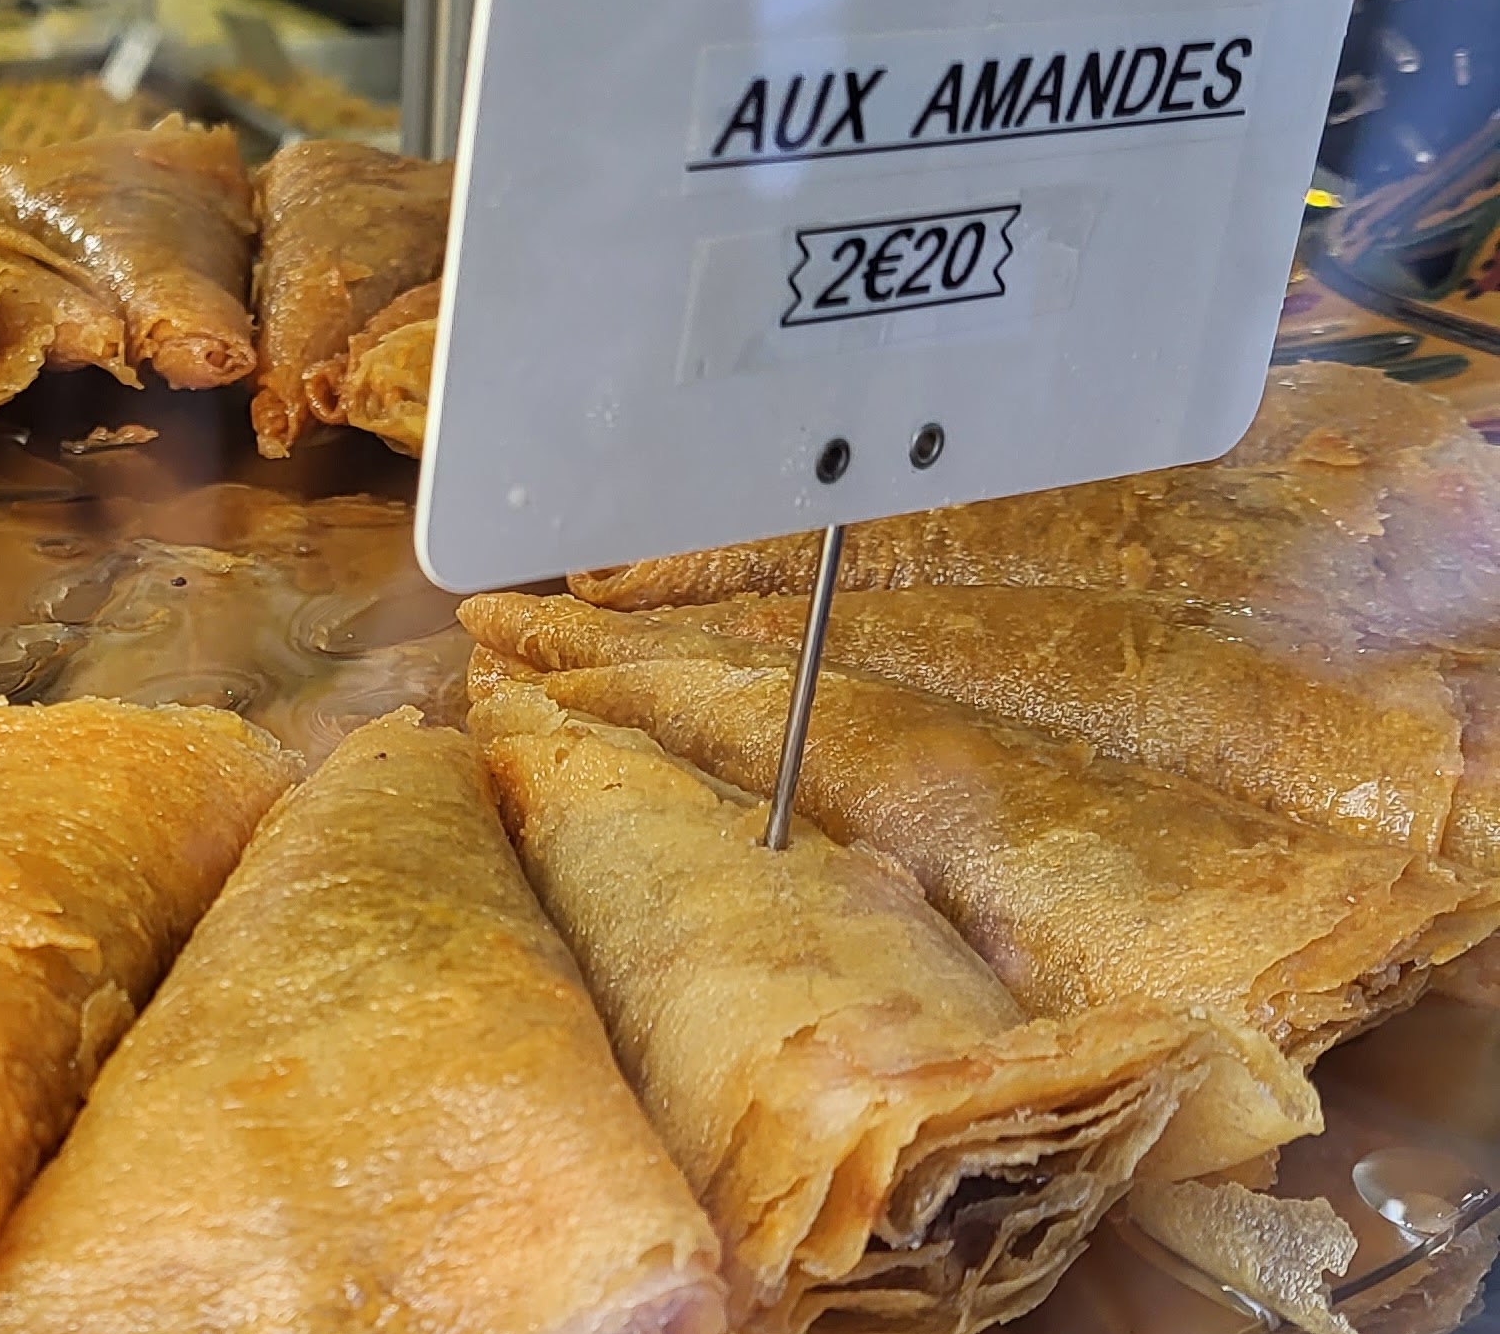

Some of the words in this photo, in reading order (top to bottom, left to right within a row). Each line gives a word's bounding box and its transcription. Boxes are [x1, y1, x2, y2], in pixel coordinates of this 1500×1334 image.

[710, 67, 888, 159] AUX
[910, 36, 1253, 140] AMANDES
[811, 218, 987, 310] 2€20
